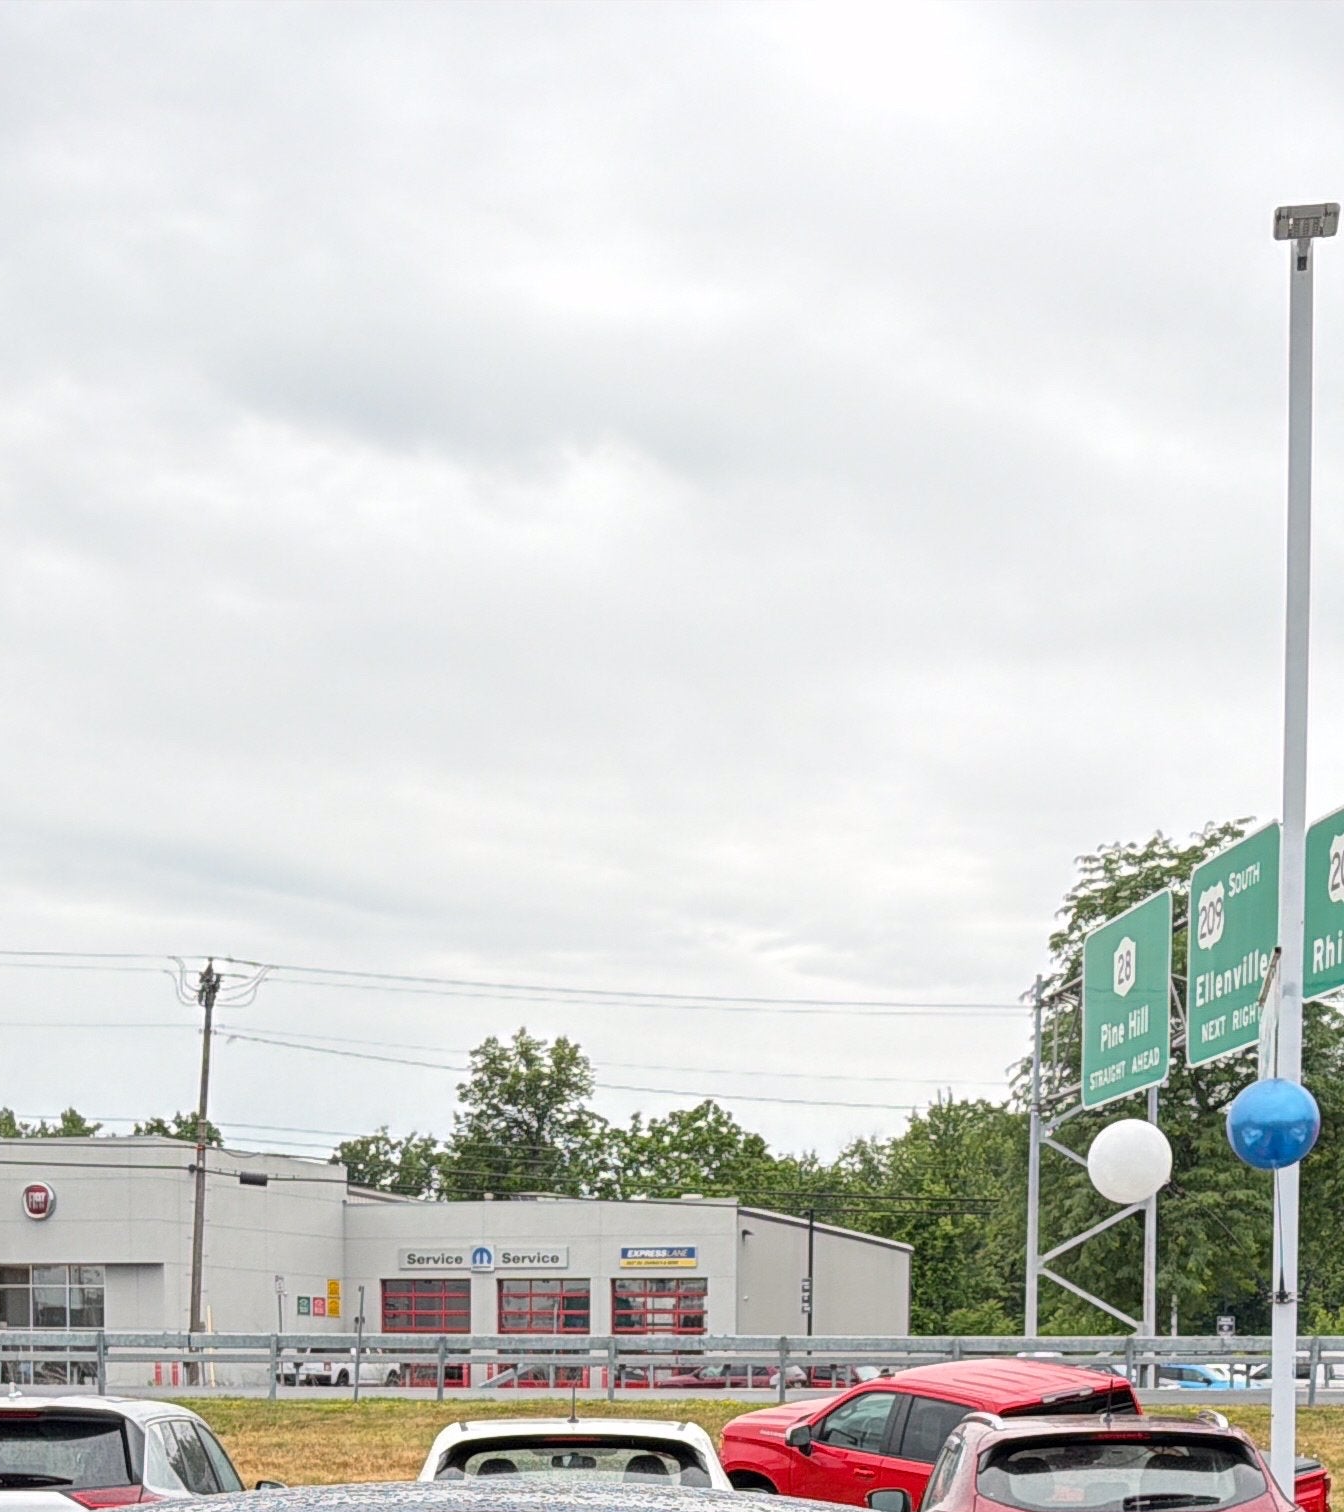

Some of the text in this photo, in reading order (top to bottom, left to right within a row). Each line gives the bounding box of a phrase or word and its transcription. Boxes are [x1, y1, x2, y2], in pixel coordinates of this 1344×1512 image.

[1228, 861, 1261, 897] SOUTH
[1199, 896, 1222, 940] 209
[1117, 950, 1132, 985] 28
[1195, 948, 1268, 1008] Ellenville
[1100, 1004, 1149, 1052] Pine Hill
[1201, 1014, 1227, 1044] NEXT
[1089, 1046, 1160, 1091] STRAIGHT AHEAD
[407, 1252, 463, 1265] Service
[501, 1252, 560, 1264] Service
